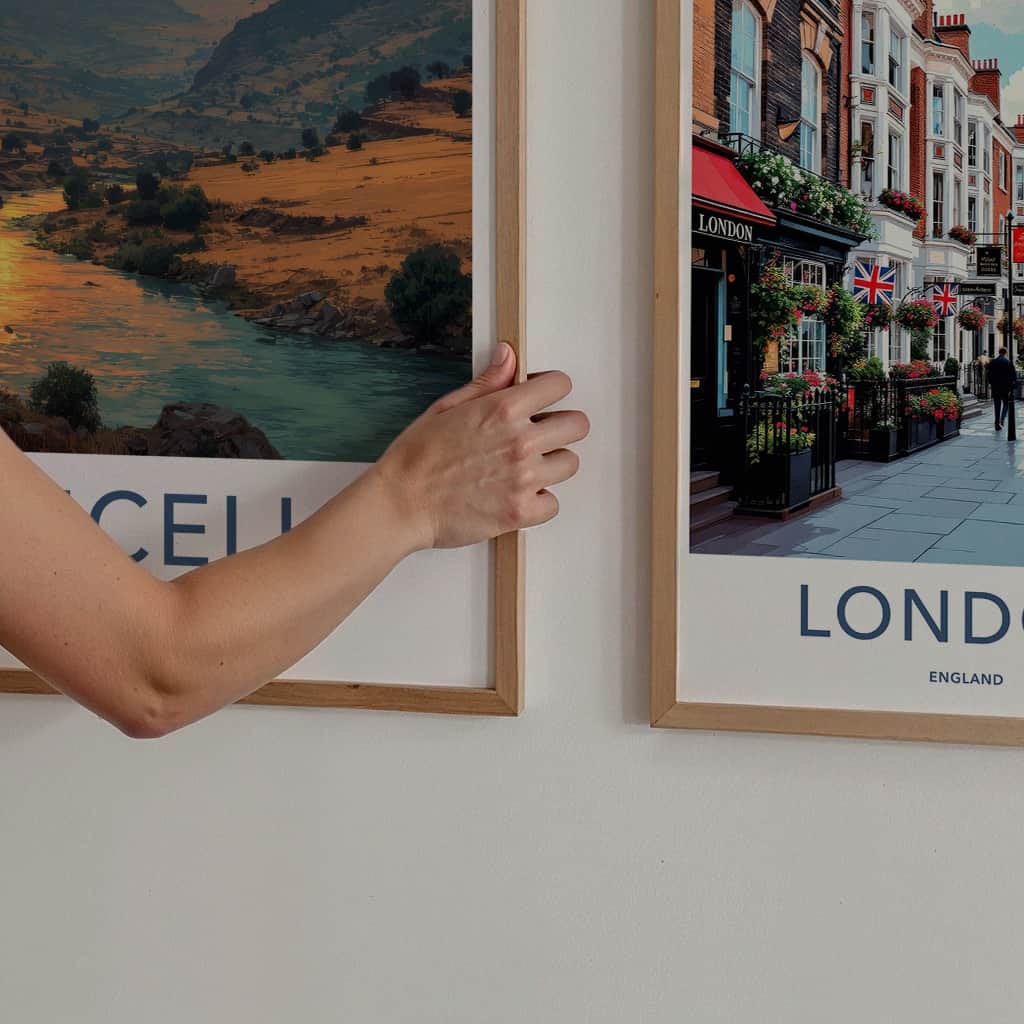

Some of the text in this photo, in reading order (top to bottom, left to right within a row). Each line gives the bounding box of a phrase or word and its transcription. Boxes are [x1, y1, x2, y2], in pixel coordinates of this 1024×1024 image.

[698, 213, 753, 242] LONDON
[801, 585, 1024, 644] LOND
[929, 671, 1004, 686] ENGLAND
